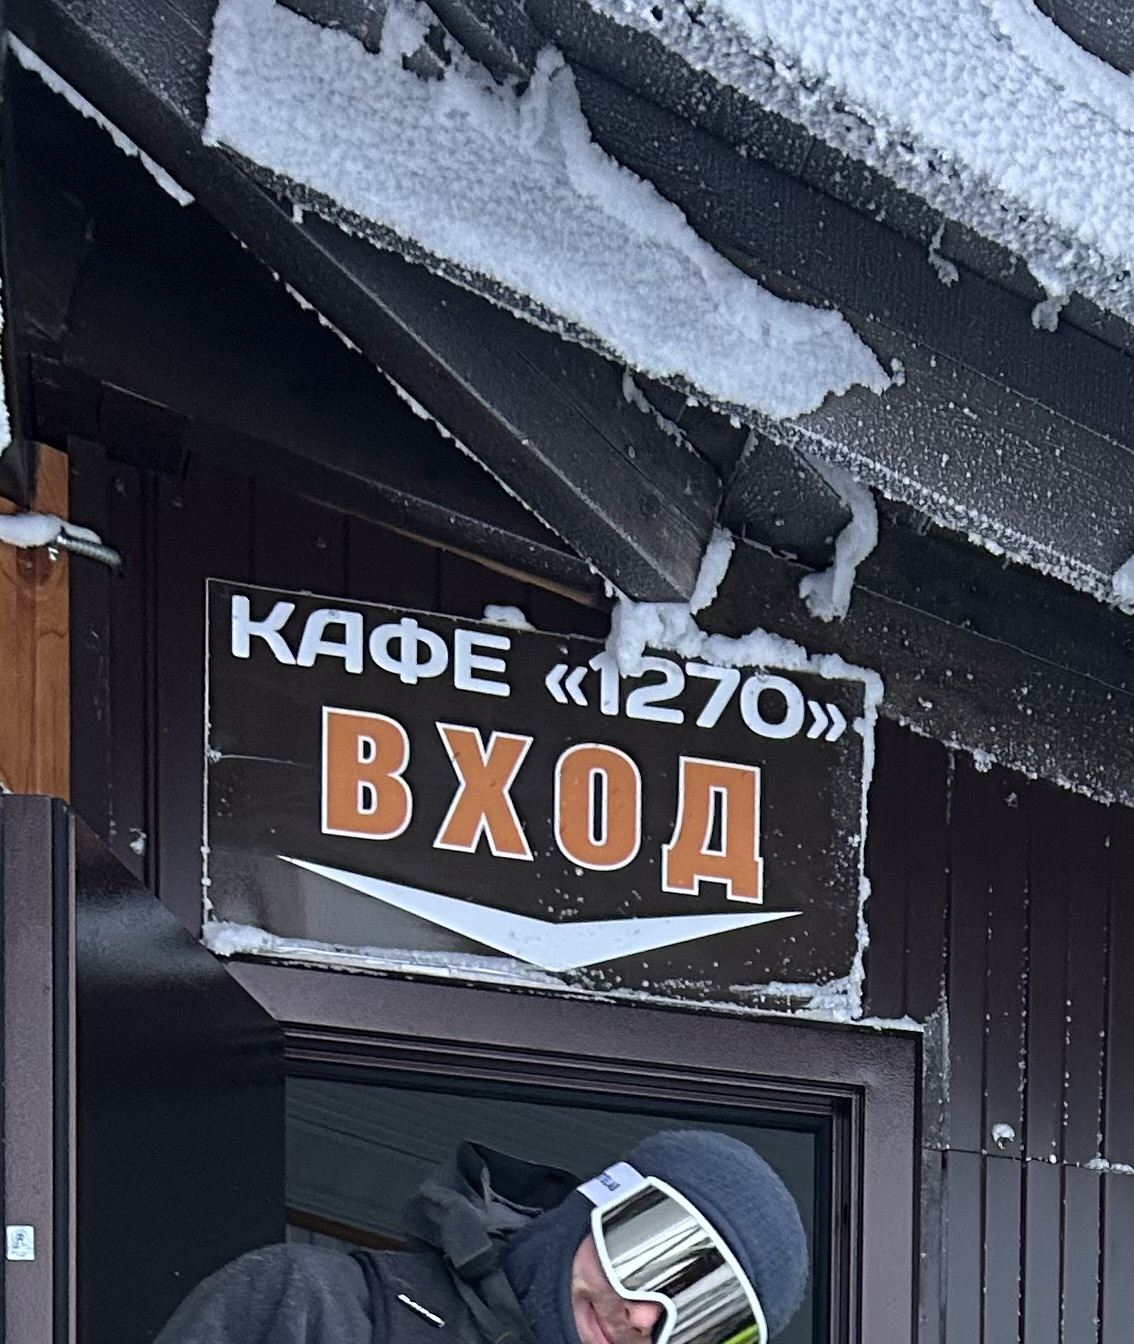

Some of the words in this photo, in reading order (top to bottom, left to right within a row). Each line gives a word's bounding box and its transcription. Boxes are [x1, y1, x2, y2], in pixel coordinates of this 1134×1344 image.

[231, 595, 511, 698] КАФЕ
[545, 651, 848, 742] «1270»
[320, 705, 764, 904] ВХОД
